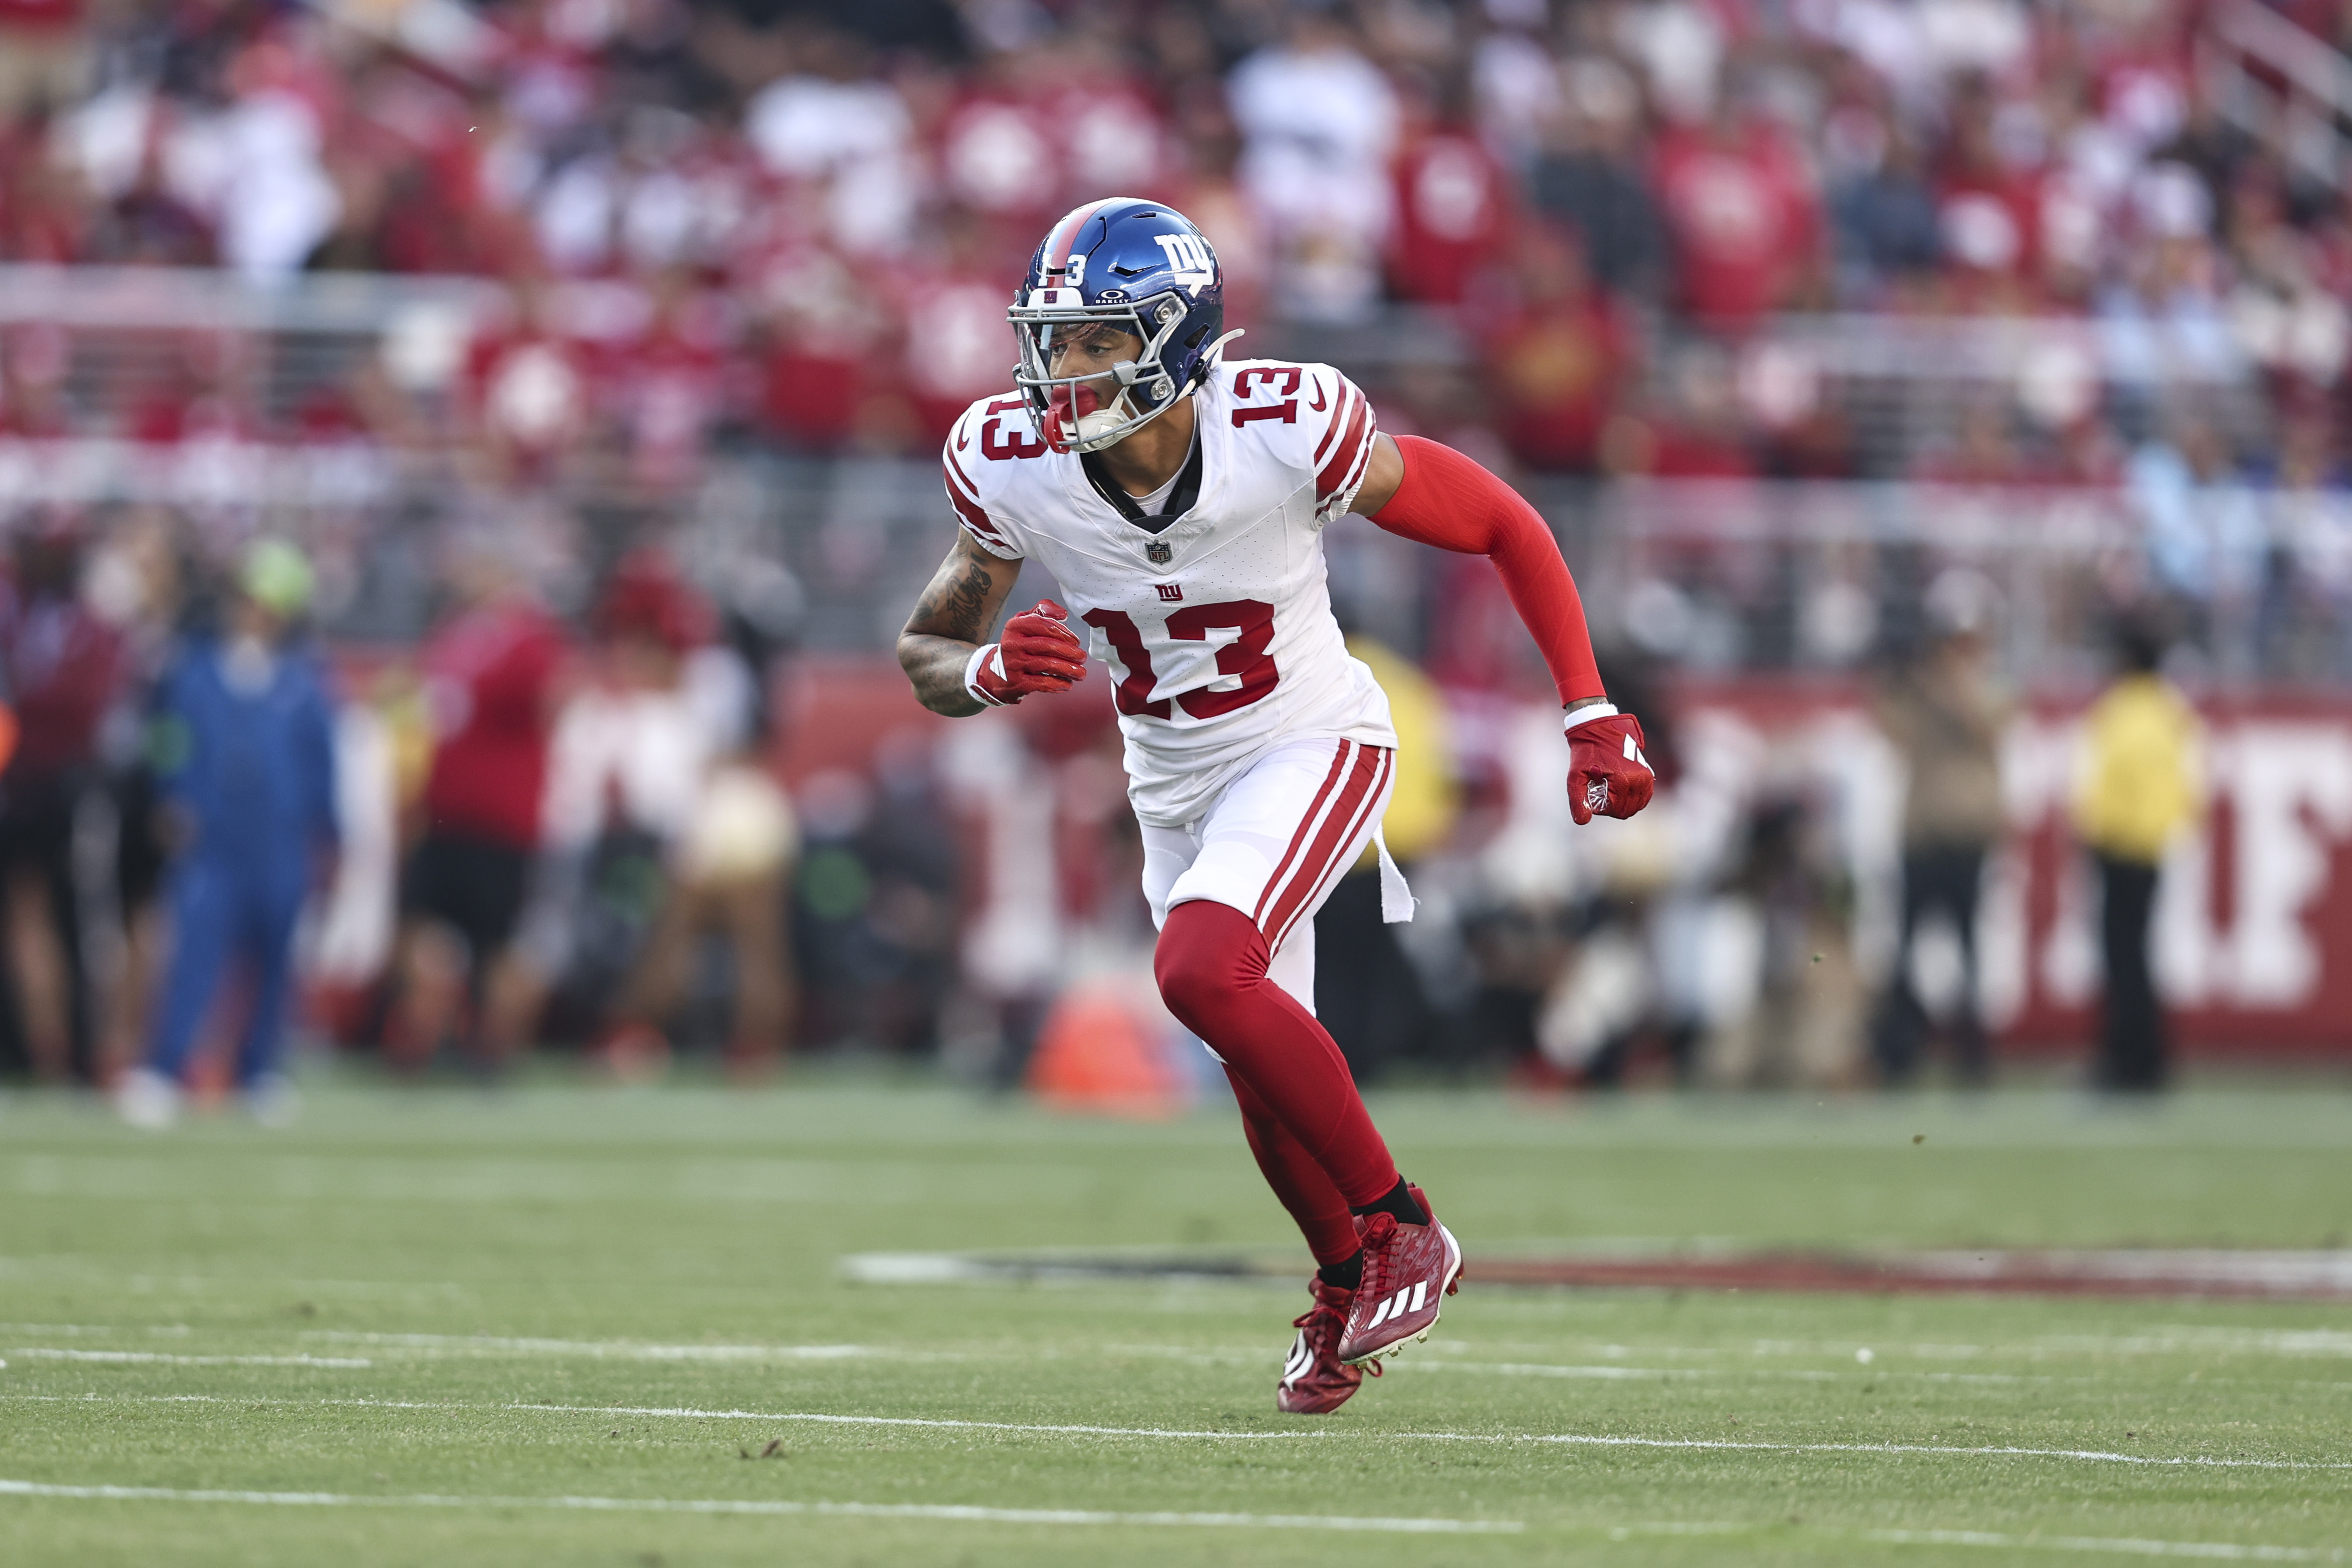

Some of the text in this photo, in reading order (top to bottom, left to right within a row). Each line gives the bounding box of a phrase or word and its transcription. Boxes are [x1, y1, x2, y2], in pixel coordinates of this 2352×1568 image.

[1038, 254, 1087, 287] 13
[1232, 367, 1303, 428] 13
[1151, 551, 1169, 561] NFL
[1081, 599, 1280, 721] 13
